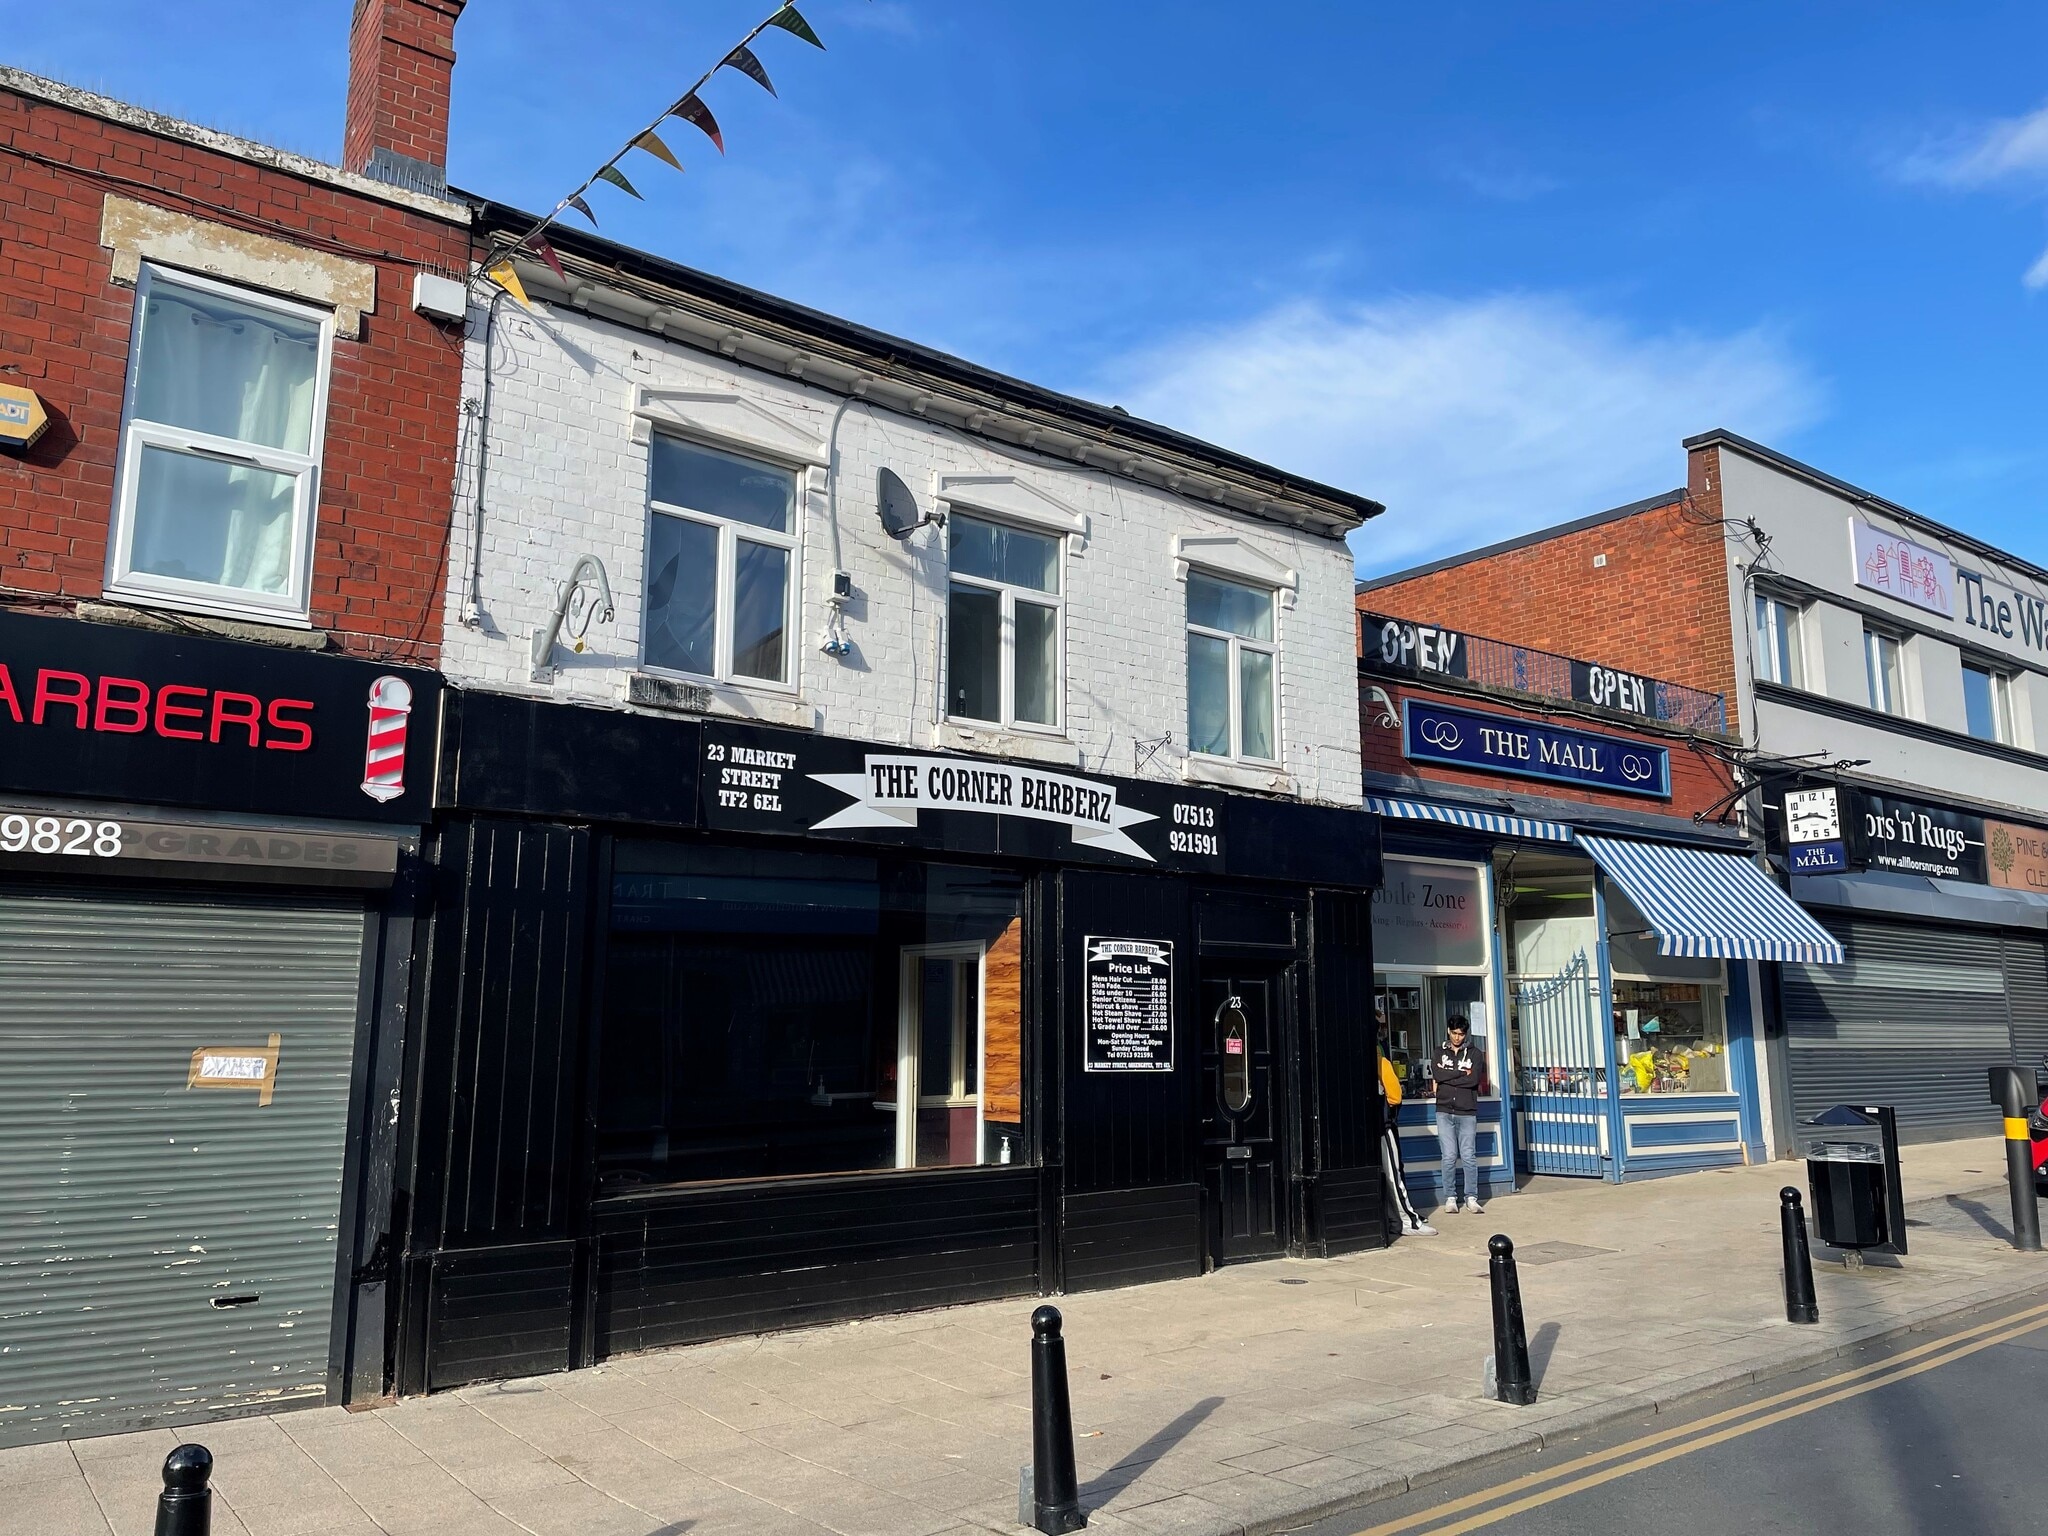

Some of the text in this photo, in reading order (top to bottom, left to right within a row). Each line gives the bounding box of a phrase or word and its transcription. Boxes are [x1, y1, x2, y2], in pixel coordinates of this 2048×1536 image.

[1957, 568, 2048, 652] The W
[1381, 621, 1456, 674] OPEN
[1589, 666, 1646, 714] OPEN
[708, 744, 796, 770] 23 MARKET
[1480, 728, 1604, 773] THE MALL
[722, 768, 782, 790] STREET
[718, 790, 782, 812] TF2 6EL
[870, 764, 1112, 824] THE CORNER BARBERZ
[1173, 803, 1214, 828] 07513
[0, 814, 122, 858] 9828
[1170, 830, 1218, 856] 921591
[1918, 814, 1965, 860] Rugs
[2016, 837, 2040, 857] PINE
[1796, 854, 1838, 867] MALL
[1878, 855, 1960, 877] www.allfloorsnrugs.com
[1422, 884, 1466, 910] Zone
[1101, 944, 1112, 953] THE
[1114, 944, 1133, 953] CORNER
[1109, 963, 1152, 974] Price List
[1230, 996, 1241, 1008] 23
